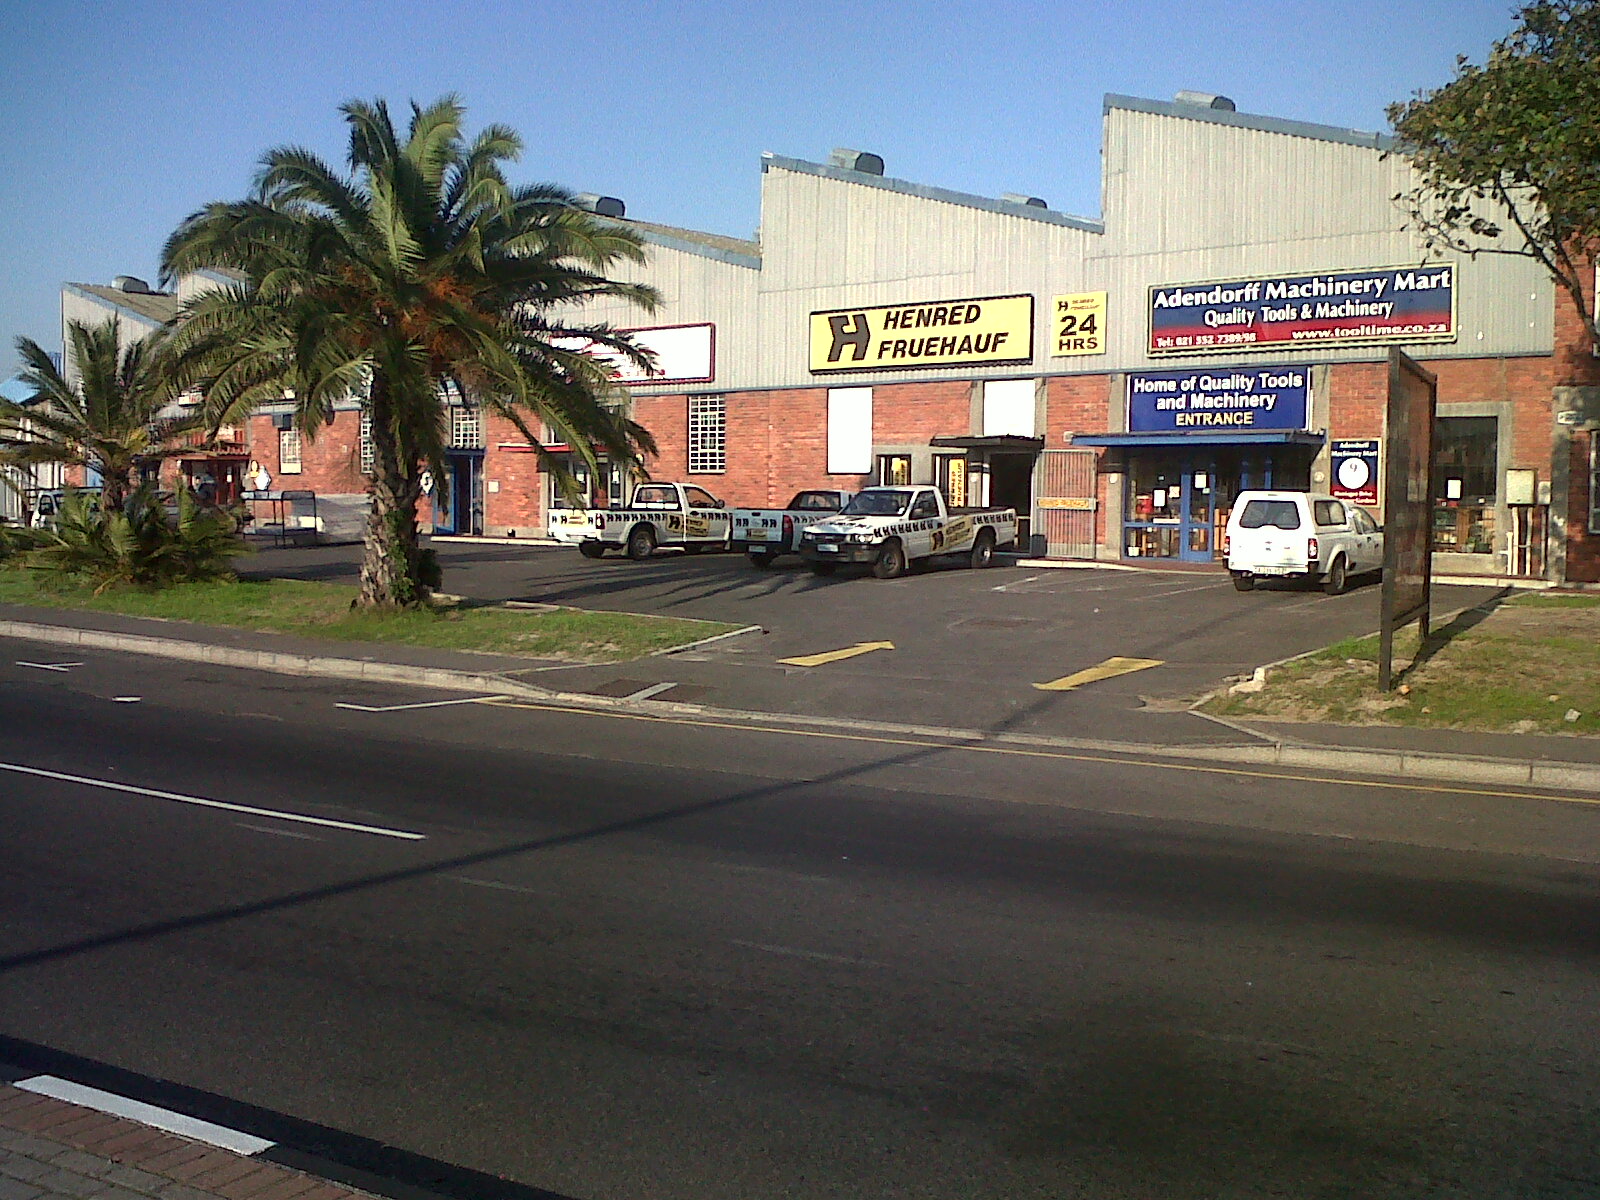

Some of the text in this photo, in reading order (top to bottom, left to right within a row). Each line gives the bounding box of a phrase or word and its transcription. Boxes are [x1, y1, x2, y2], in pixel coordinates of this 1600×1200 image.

[1153, 269, 1451, 308] Adendorff Machinery Mart
[883, 304, 981, 330] HENRED
[1204, 299, 1393, 328] Quality Tools & Machinery
[1060, 313, 1098, 337] 24
[1292, 323, 1447, 339] www.tooltime.co.za
[877, 332, 1009, 360] FRUEHAUF
[1059, 337, 1098, 351] HRS
[1134, 372, 1303, 393] Home of Quality Tools
[1156, 392, 1276, 410] and Machinery
[1176, 412, 1253, 426] ENTRANCE
